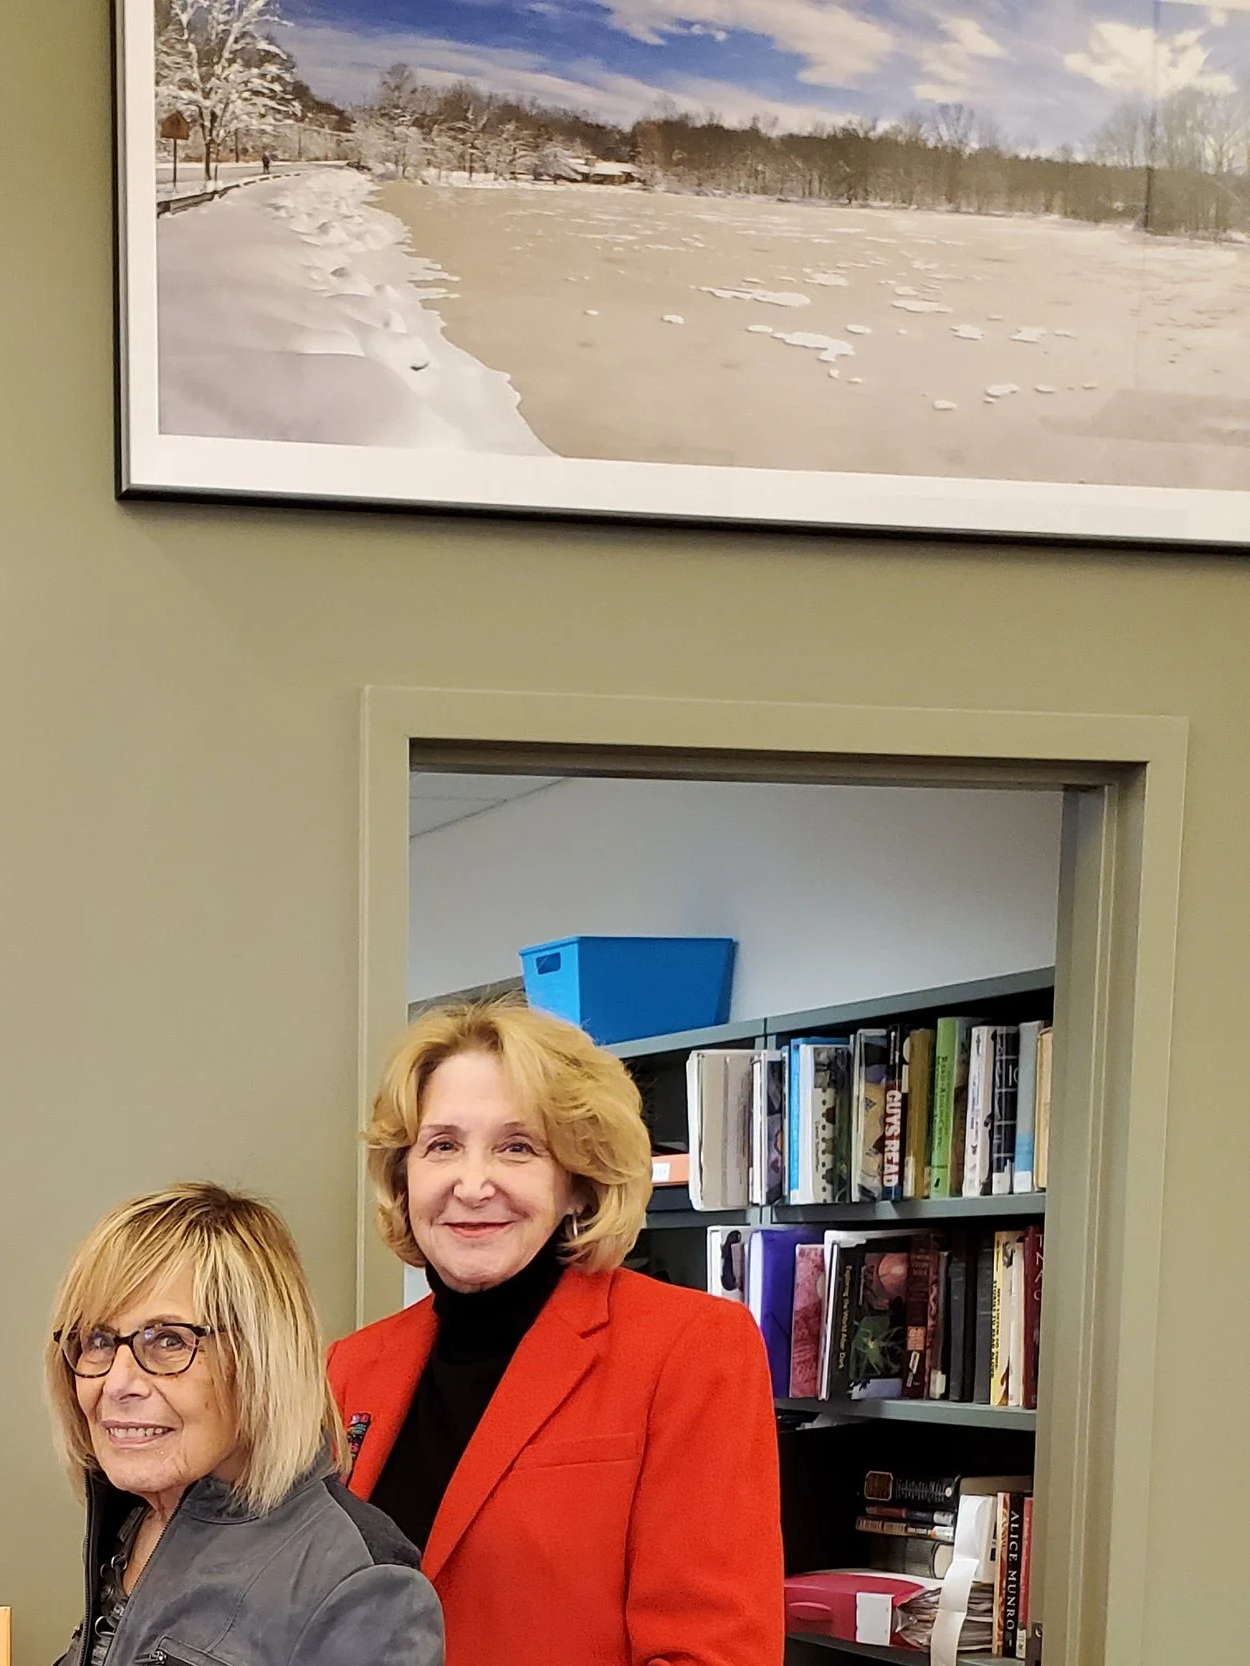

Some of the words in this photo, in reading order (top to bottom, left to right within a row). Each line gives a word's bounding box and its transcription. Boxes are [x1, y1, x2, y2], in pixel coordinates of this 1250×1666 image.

[885, 1089, 902, 1134] GUYS
[883, 1140, 899, 1187] READ
[1006, 1509, 1020, 1563] ALICE
[1005, 1569, 1017, 1631] MUNRO
